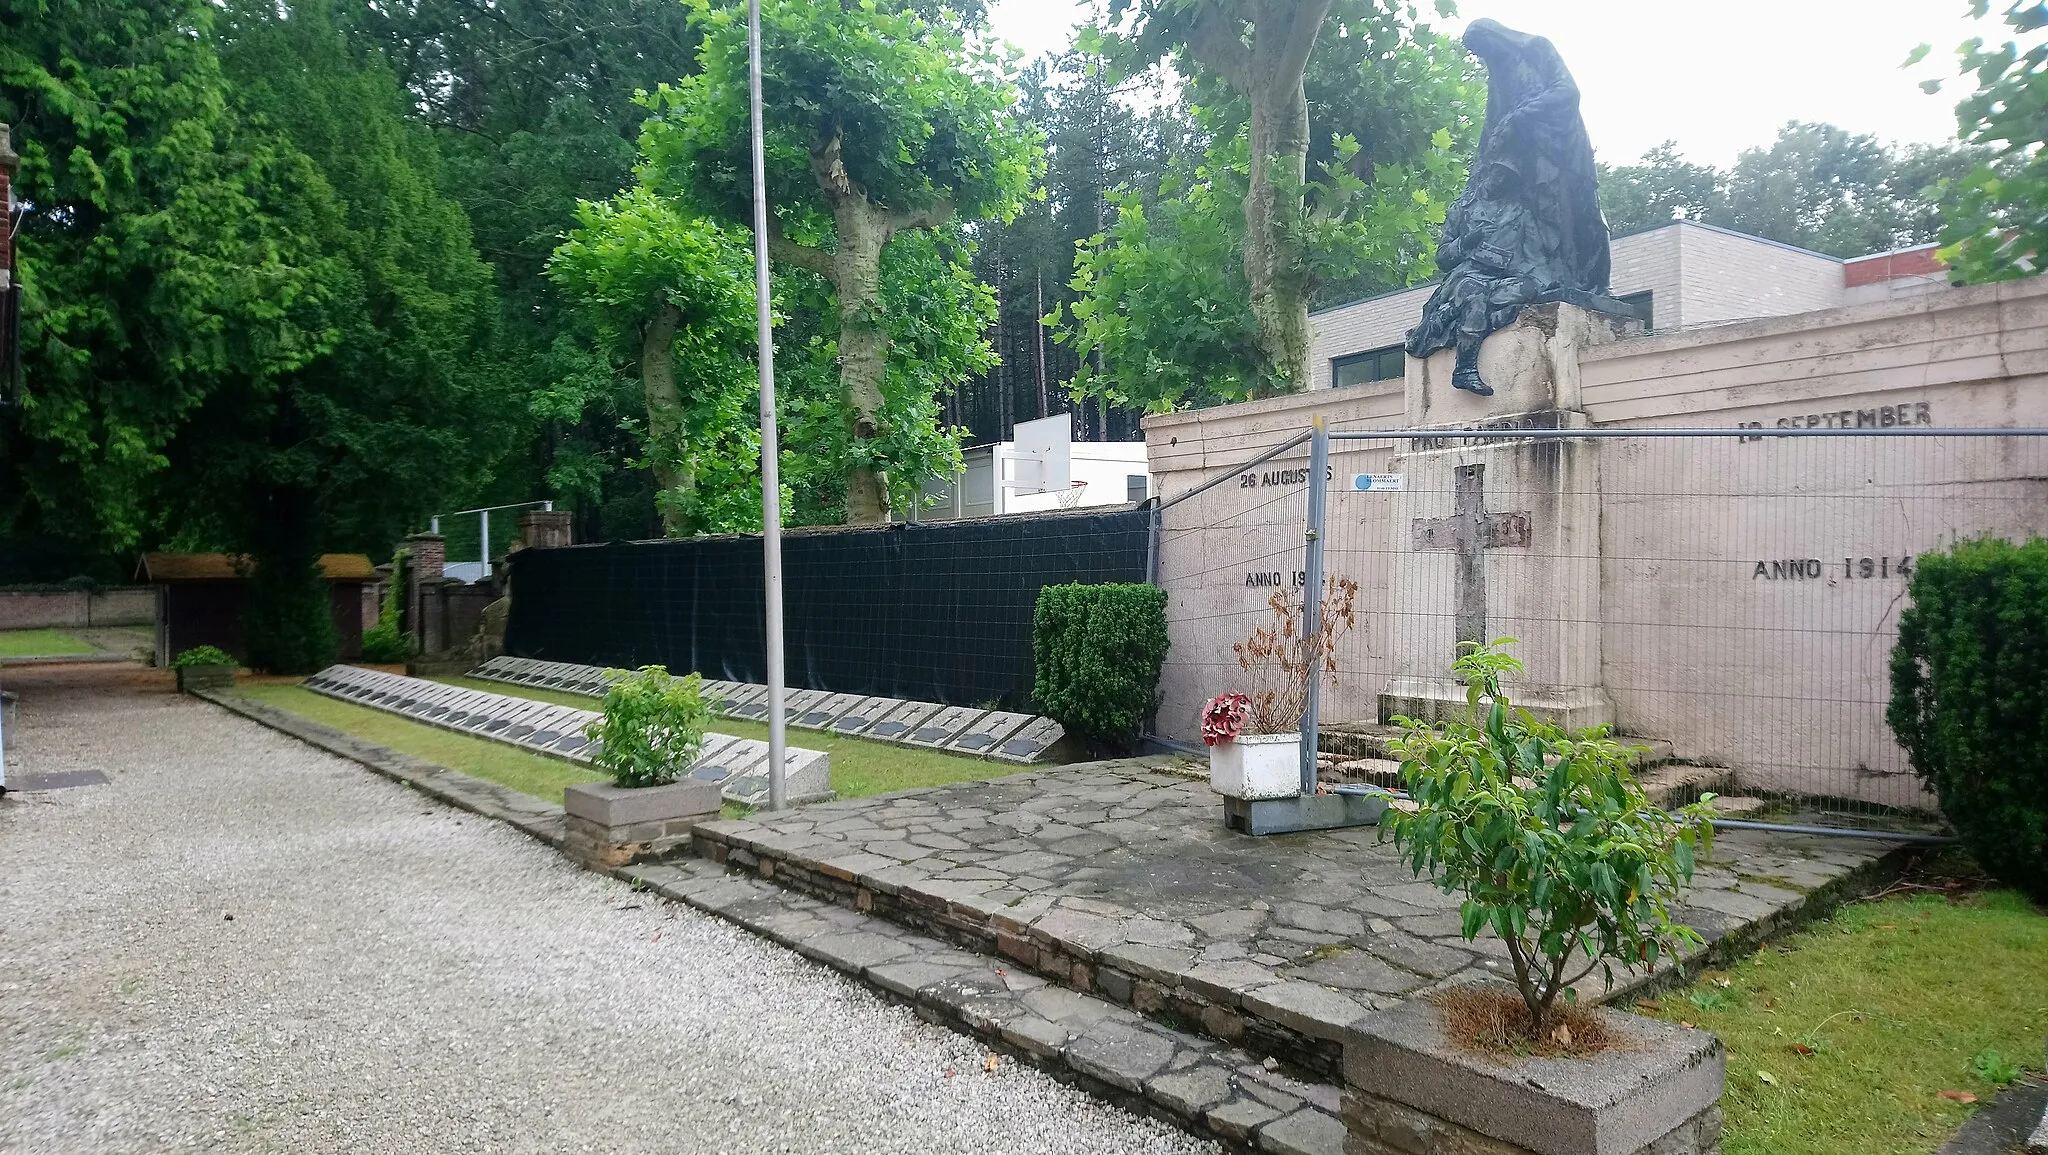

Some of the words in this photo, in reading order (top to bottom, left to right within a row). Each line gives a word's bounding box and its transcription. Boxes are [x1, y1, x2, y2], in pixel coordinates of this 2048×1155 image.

[1776, 402, 1932, 438] SEPTEMBER
[1240, 473, 1256, 489] 26
[1260, 465, 1333, 488] AUGUSTS
[1245, 571, 1281, 587] ANNO
[1291, 571, 1325, 587] 19
[1752, 559, 1822, 581] ANNO
[1845, 556, 1913, 580] 1914
